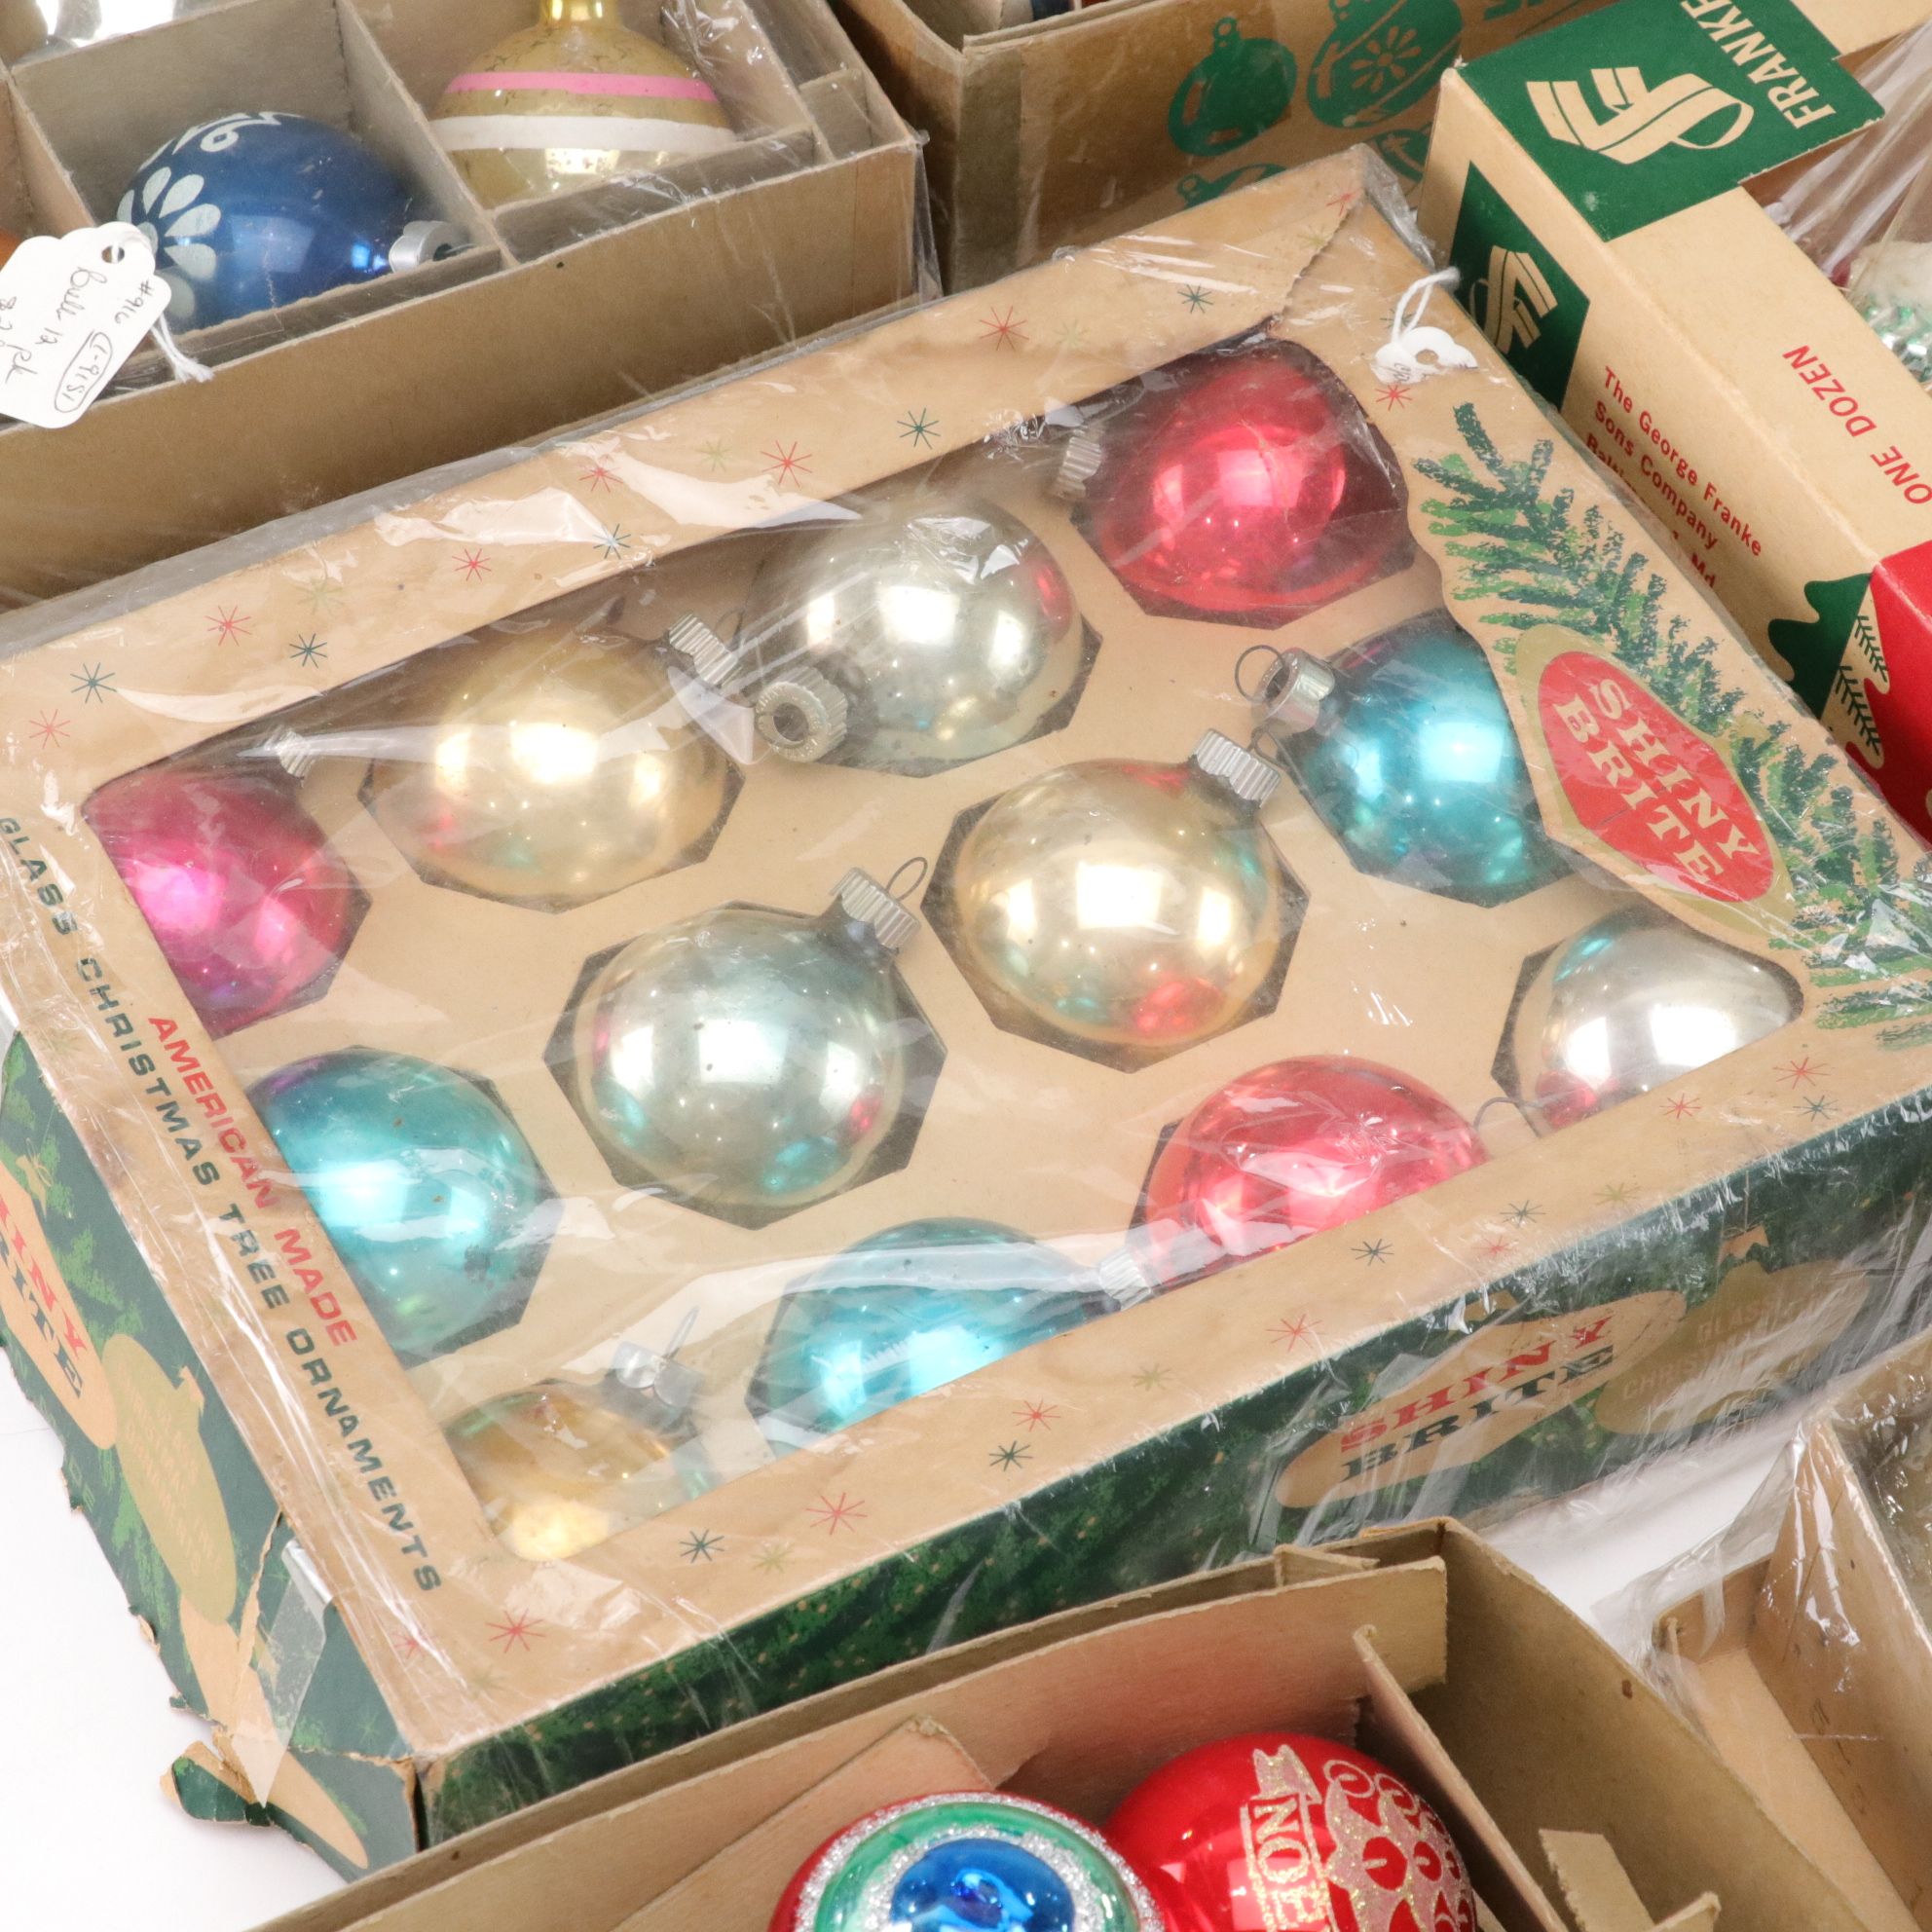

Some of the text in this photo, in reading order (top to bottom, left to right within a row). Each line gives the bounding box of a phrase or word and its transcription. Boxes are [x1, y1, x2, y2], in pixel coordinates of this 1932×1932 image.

[1594, 400, 1634, 457] Sons
[1640, 454, 1718, 551] Company
[1605, 366, 1633, 413] The
[1639, 410, 1698, 486] George
[1704, 482, 1762, 556] Franke
[1782, 345, 1932, 504] ONE DOZEN
[1552, 693, 1724, 883] BRITE
[1589, 679, 1761, 859] SHINY
[0, 818, 441, 1591] GLASS CHRISTMAS TREE ORNAMENTS
[148, 1016, 357, 1346] AMERICAN MADE
[0, 1198, 87, 1359] INY
[0, 1231, 83, 1399] ITE
[1340, 1344, 1613, 1482] BRITE
[1341, 1317, 1612, 1453] SHINY
